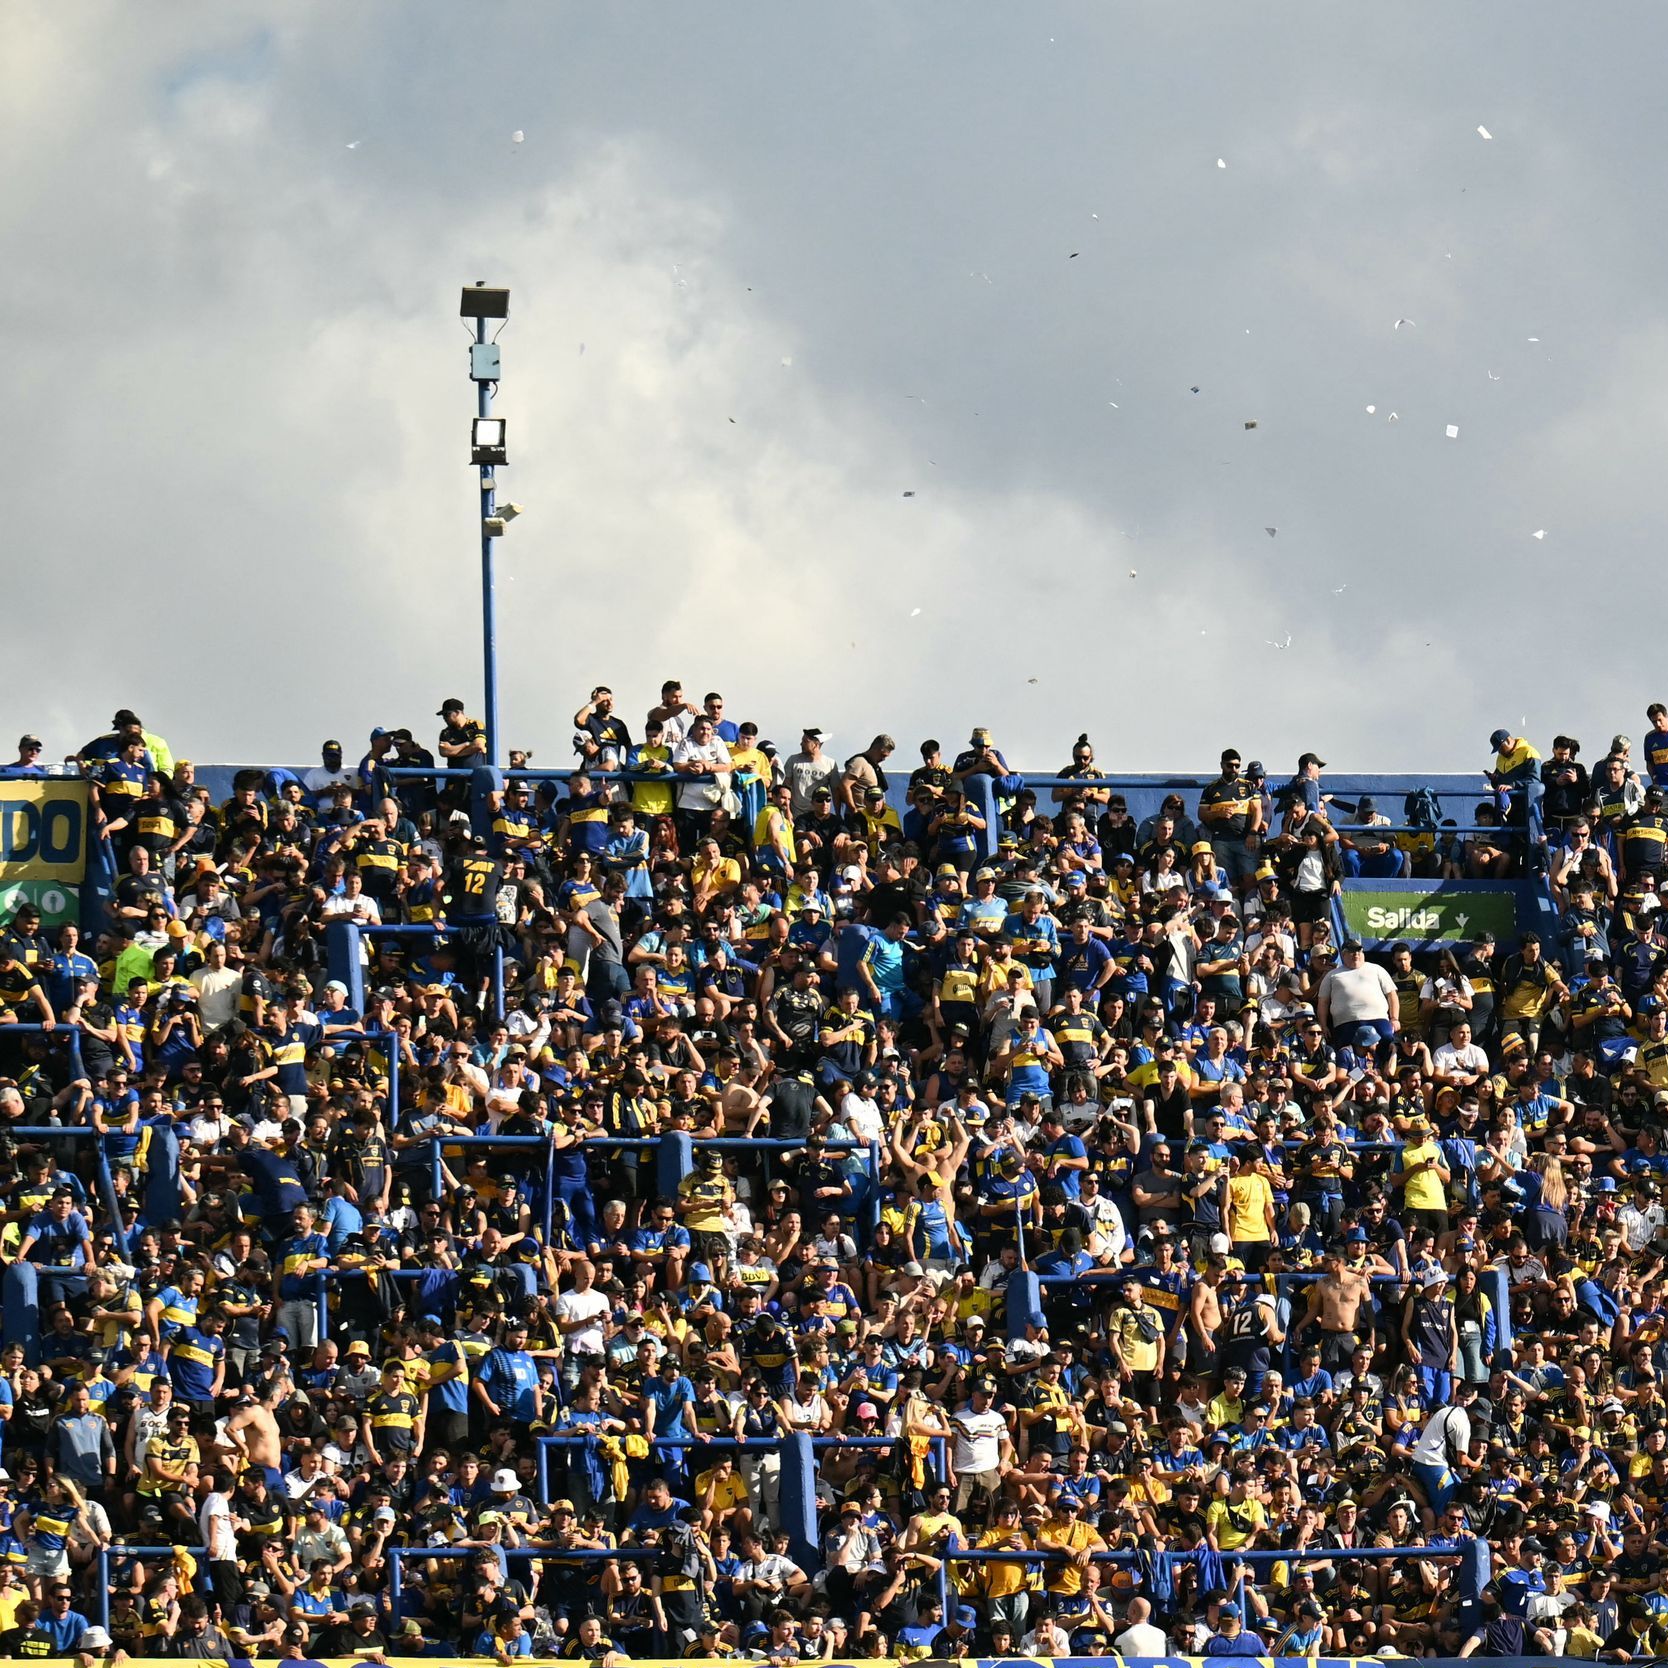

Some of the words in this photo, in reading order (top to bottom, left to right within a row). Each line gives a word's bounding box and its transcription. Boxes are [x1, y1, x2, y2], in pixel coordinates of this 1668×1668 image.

[464, 871, 485, 895] 12
[1367, 906, 1440, 931] Salida
[741, 1271, 766, 1282] BBVA
[1232, 1310, 1254, 1336] 12
